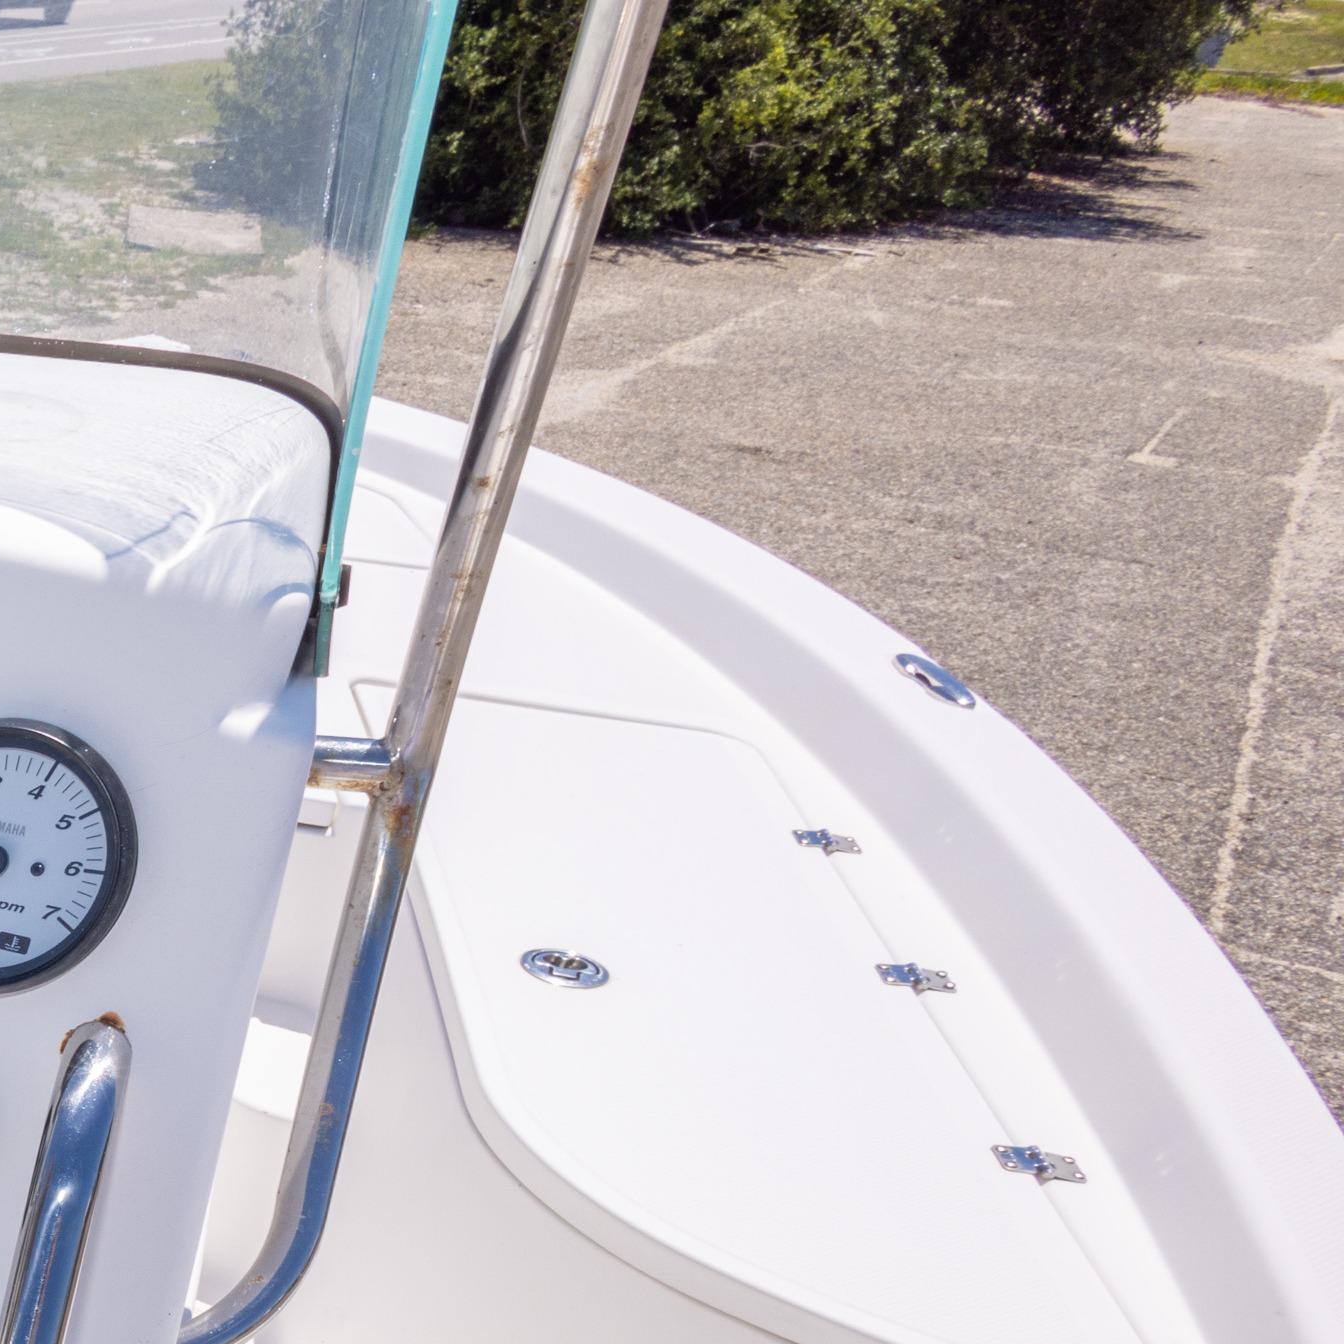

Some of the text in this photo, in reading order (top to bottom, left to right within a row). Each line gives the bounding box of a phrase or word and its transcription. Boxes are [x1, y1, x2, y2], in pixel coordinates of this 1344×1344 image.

[27, 785, 46, 801] 4
[55, 814, 76, 830] 5
[64, 861, 84, 876] 6
[41, 905, 62, 920] 7
